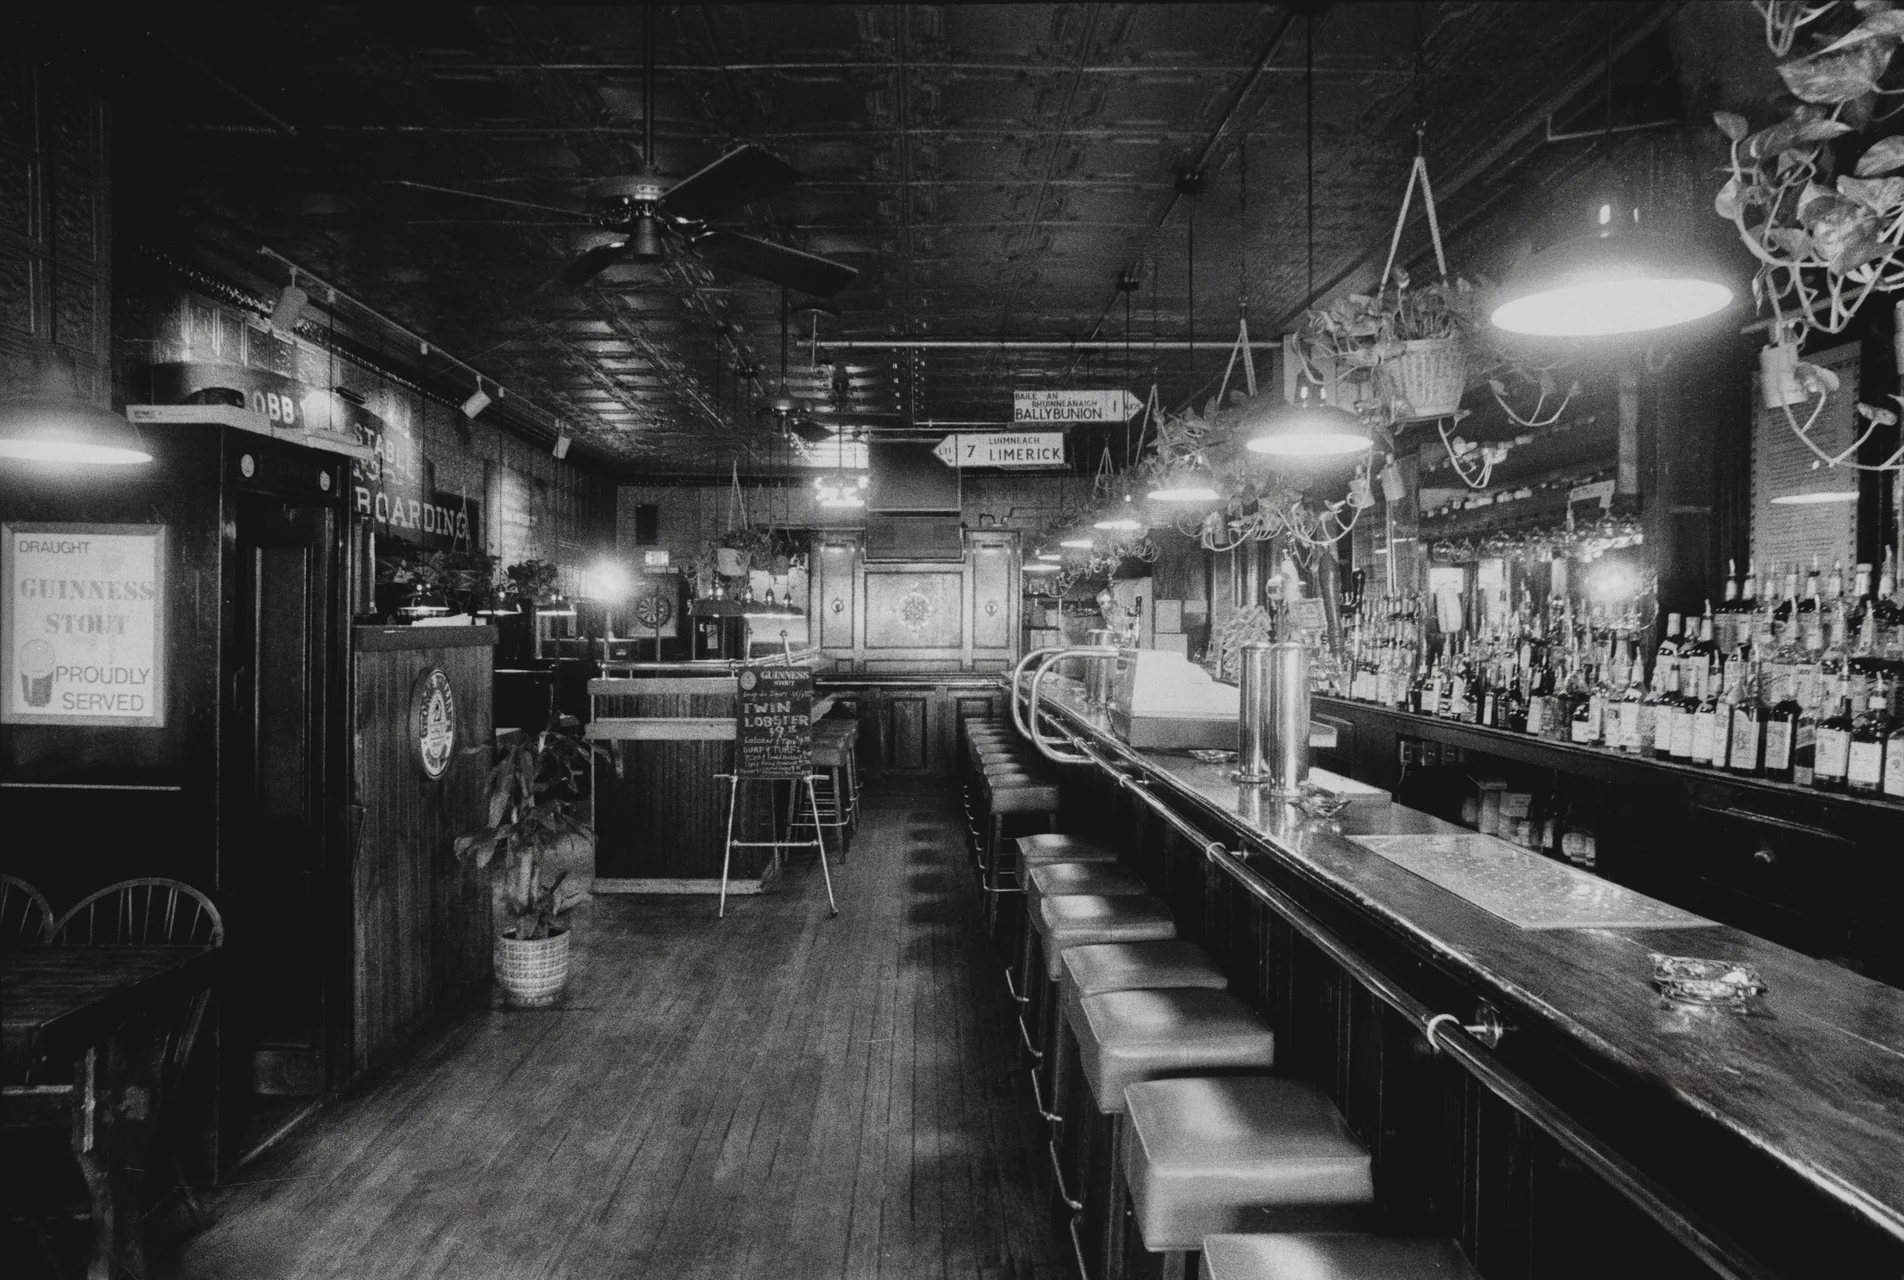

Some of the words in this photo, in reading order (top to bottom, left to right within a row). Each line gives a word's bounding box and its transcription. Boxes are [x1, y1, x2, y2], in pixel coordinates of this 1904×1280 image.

[1014, 392, 1038, 400] BAILE
[1046, 392, 1059, 400] AN
[252, 389, 294, 425] OBB
[1014, 408, 1103, 421] BALLYBUNION
[988, 436, 1041, 446] LUIMNEACH
[966, 444, 977, 459] 7
[988, 447, 1062, 462] LIMERICK
[18, 540, 91, 555] DRAUGHT
[20, 578, 154, 601] GUINNESS
[45, 613, 129, 636] STOUT
[55, 665, 151, 685] PROUDLY
[759, 670, 811, 680] GUINNESS
[61, 691, 145, 712] SERVED
[743, 701, 791, 714] TWIN
[744, 715, 809, 728] LOBSTER
